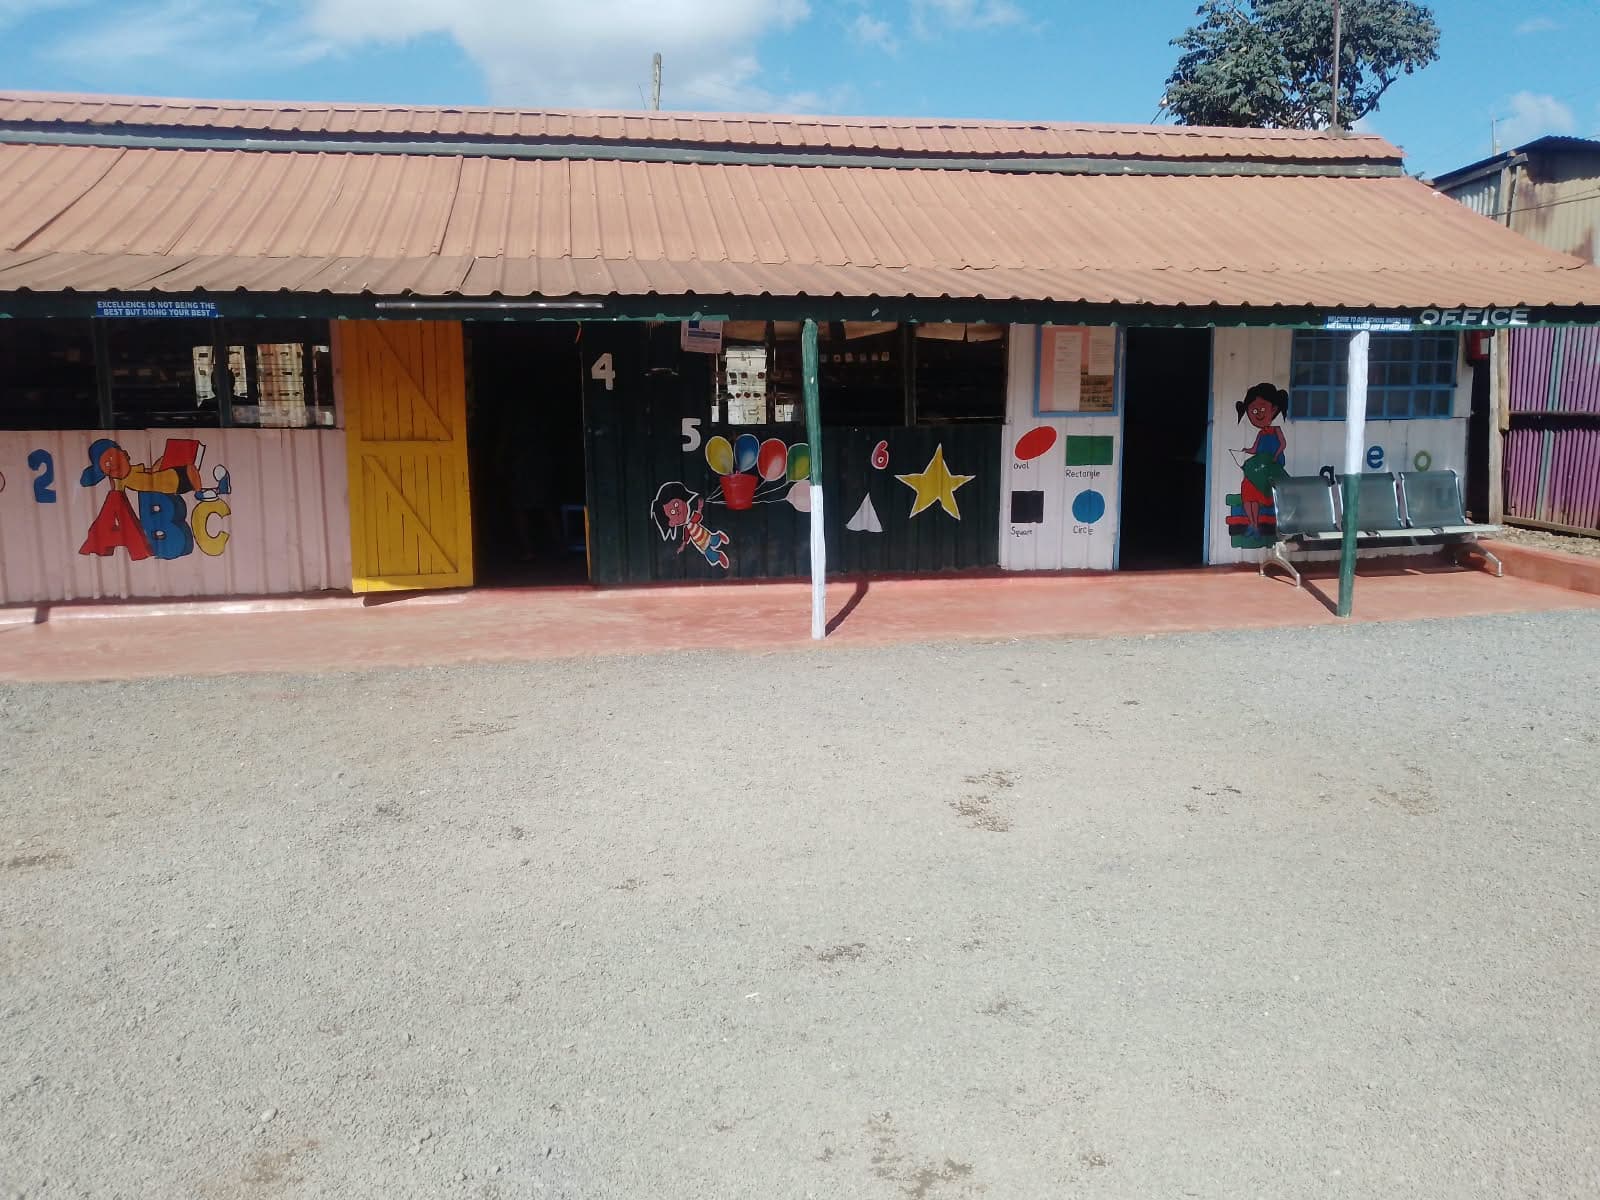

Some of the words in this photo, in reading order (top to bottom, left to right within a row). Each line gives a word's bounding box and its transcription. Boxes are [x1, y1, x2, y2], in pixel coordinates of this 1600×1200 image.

[97, 301, 146, 309] EXCELLENCE
[149, 301, 156, 309] IS
[158, 301, 172, 309] NOT
[175, 302, 199, 310] BEING
[201, 302, 216, 310] THE
[104, 308, 123, 316] BEST
[125, 308, 140, 316] BUT
[143, 308, 167, 316] DOING
[169, 309, 189, 317] YOUR
[191, 309, 210, 317] BEST
[1419, 307, 1530, 326] OFFICE
[591, 353, 615, 390] 4
[682, 418, 701, 451] 5
[871, 440, 889, 469] 6
[1367, 446, 1384, 468] e
[1414, 450, 1432, 472] o
[28, 449, 56, 503] 2
[1065, 469, 1100, 479] Rectangle
[1073, 526, 1093, 535] Circle
